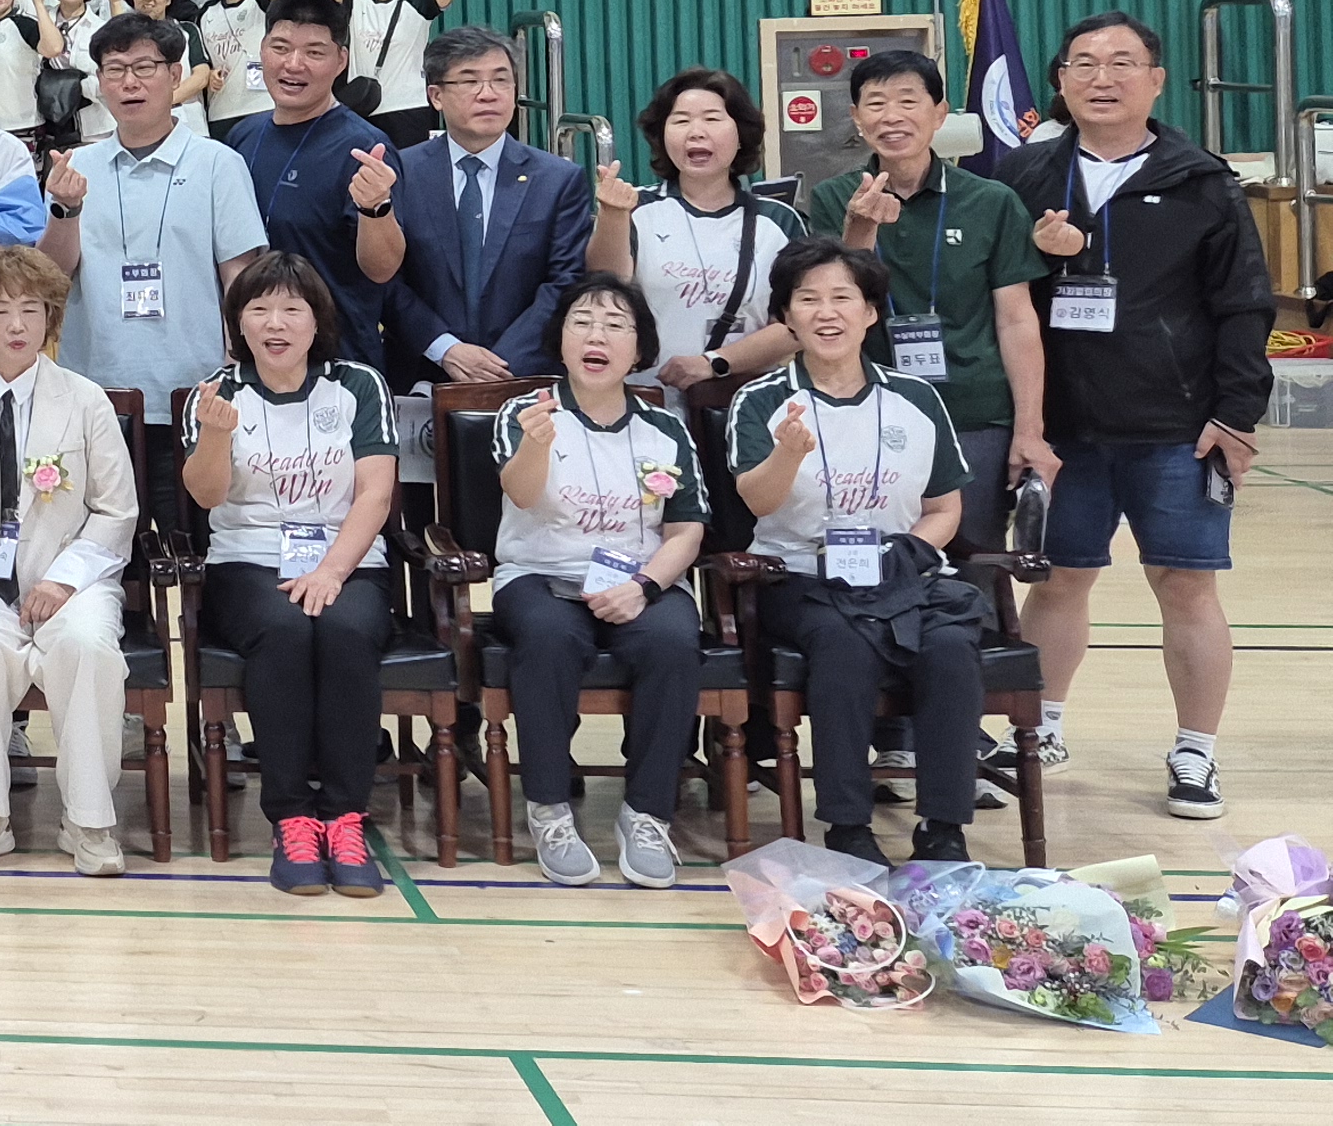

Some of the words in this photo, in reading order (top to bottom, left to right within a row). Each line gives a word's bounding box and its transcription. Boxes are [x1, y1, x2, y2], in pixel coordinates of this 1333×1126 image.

[247, 447, 318, 475] Ready
[324, 446, 346, 466] to
[270, 469, 332, 505] Win
[882, 468, 902, 485] to
